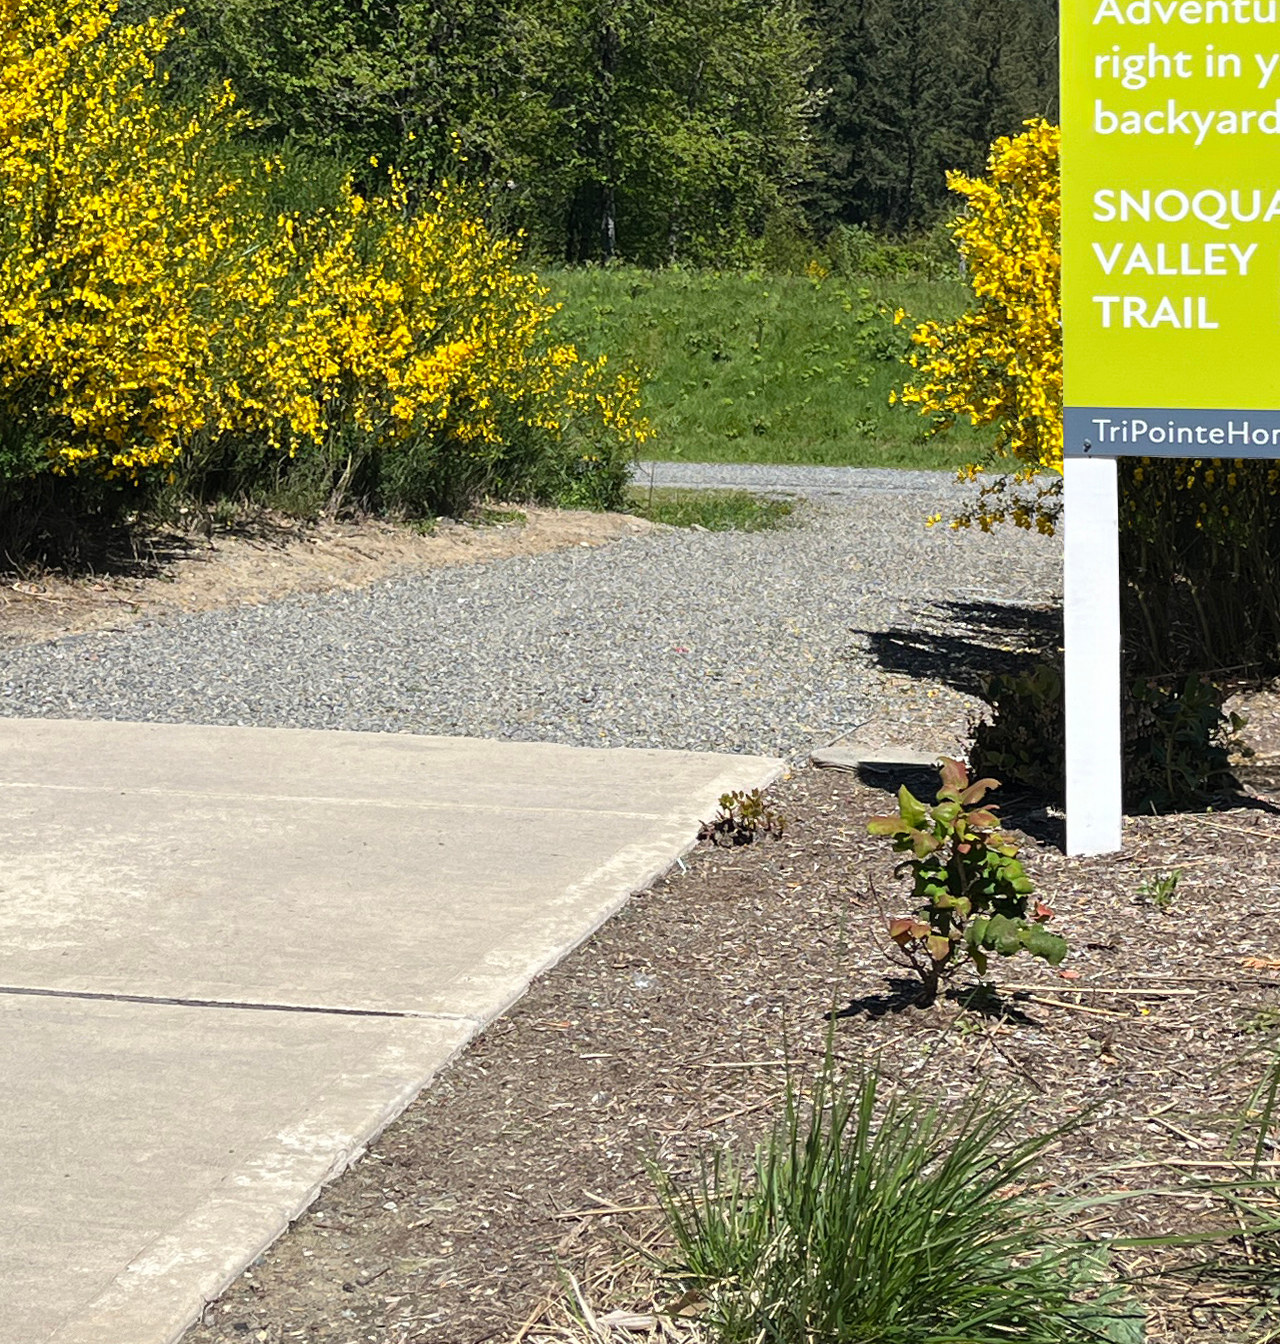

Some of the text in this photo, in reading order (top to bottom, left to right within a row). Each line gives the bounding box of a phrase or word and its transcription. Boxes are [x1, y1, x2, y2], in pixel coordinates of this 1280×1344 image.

[1094, 43, 1192, 90] right
[1206, 44, 1241, 77] in
[1092, 243, 1258, 275] VALLEY
[1093, 295, 1219, 329] TRAIL
